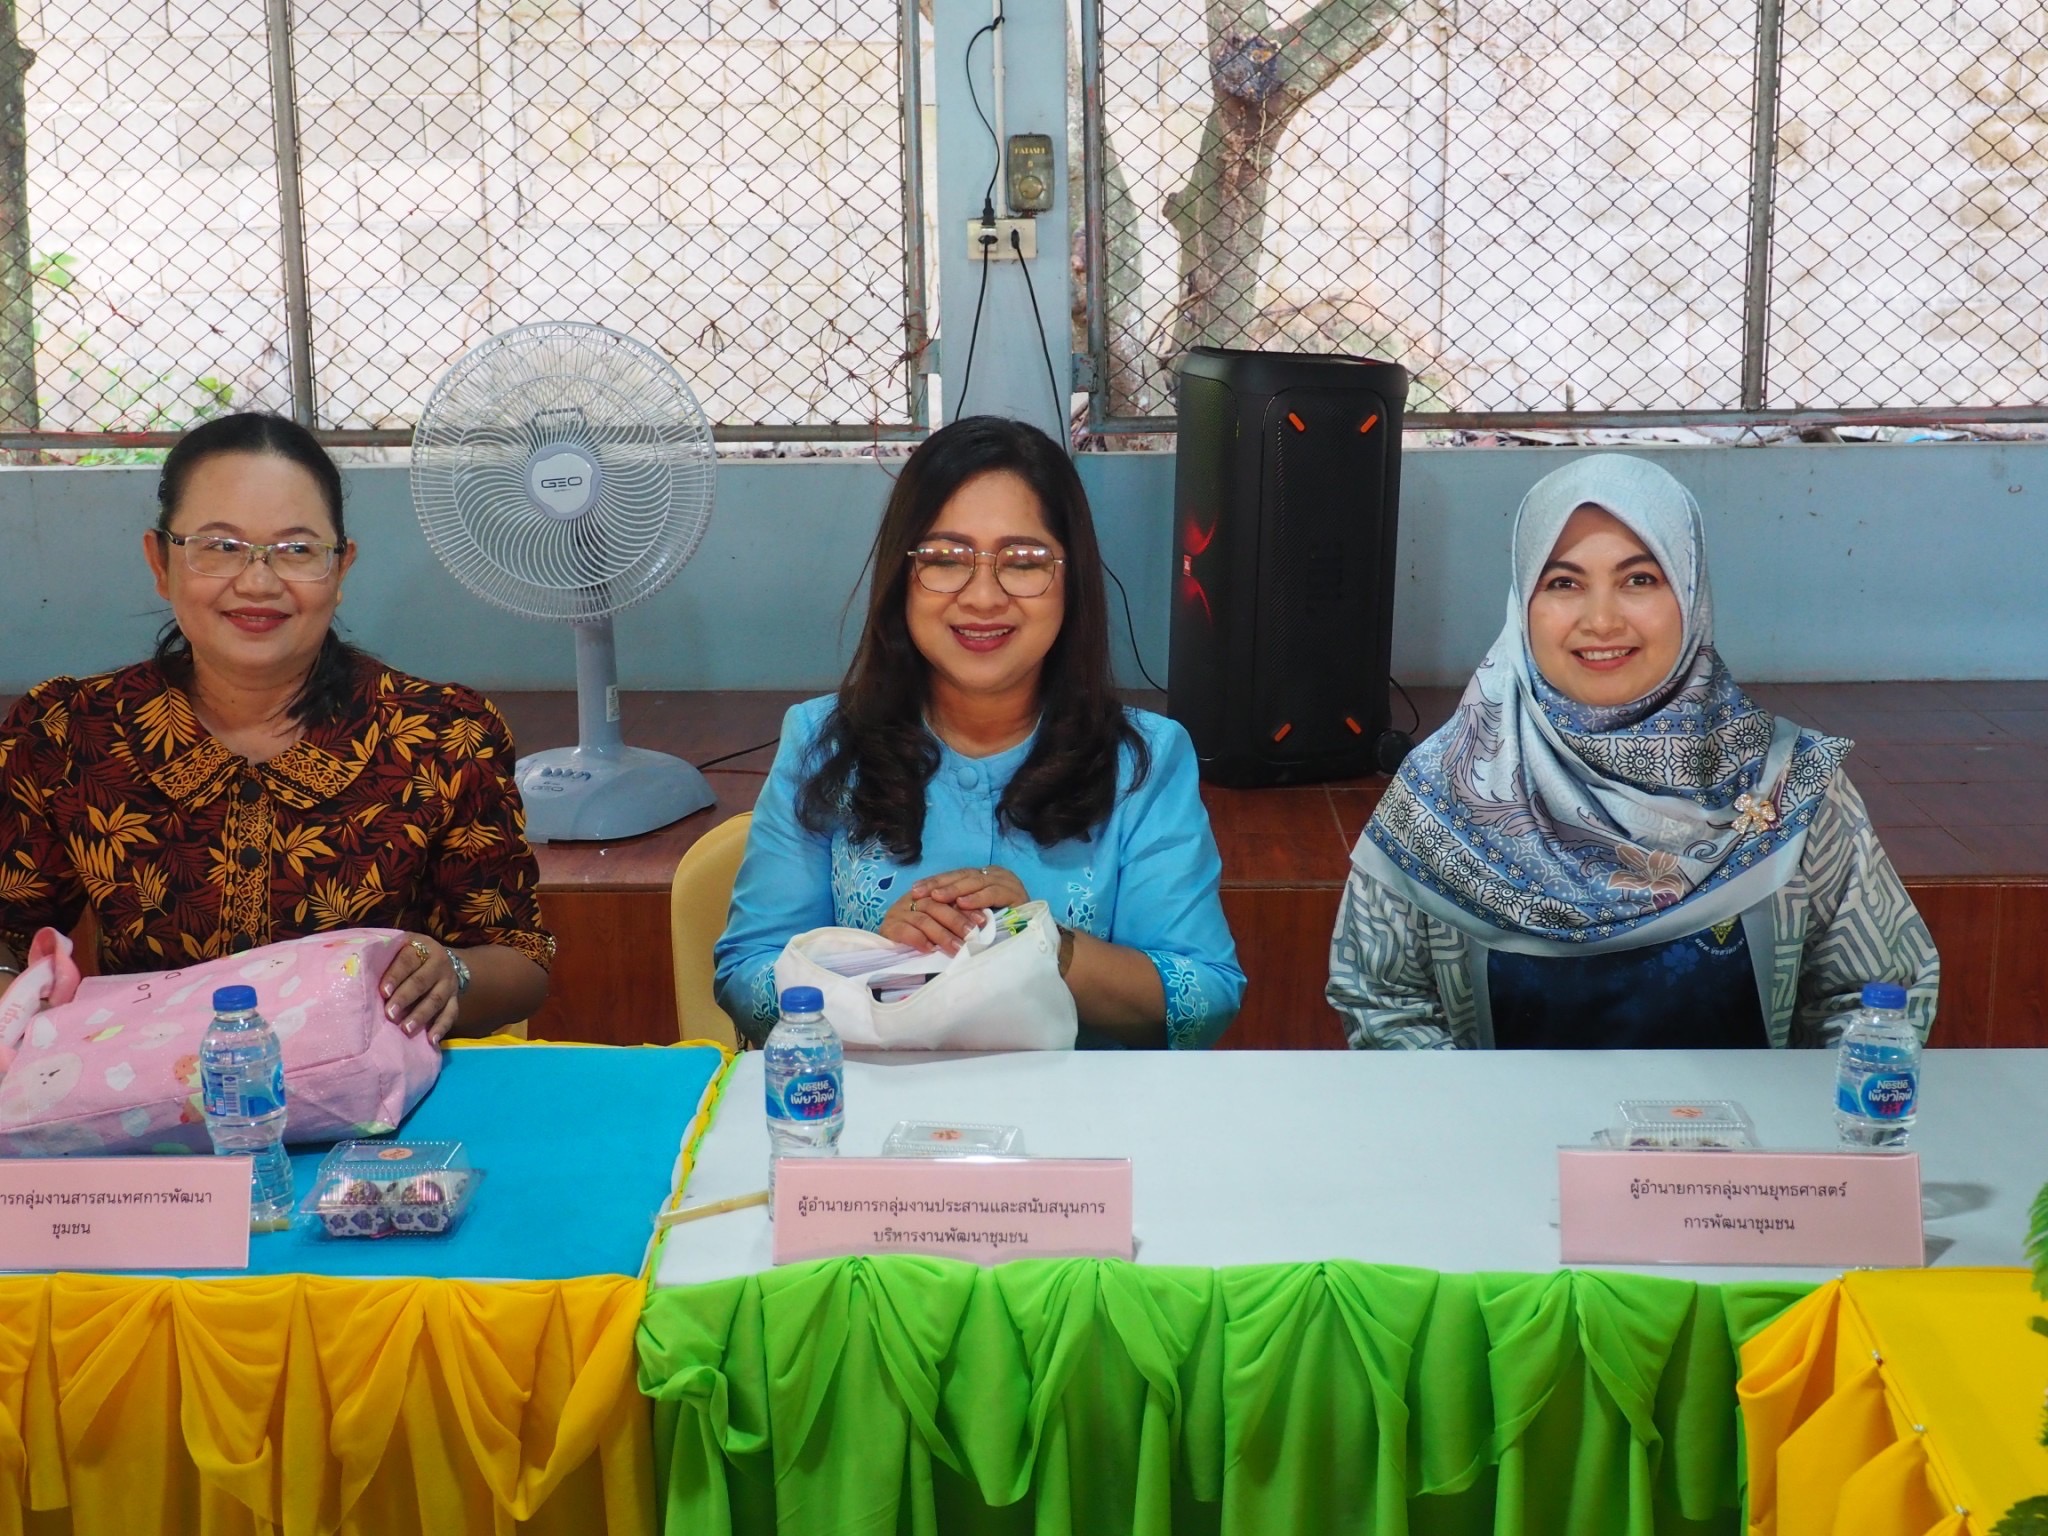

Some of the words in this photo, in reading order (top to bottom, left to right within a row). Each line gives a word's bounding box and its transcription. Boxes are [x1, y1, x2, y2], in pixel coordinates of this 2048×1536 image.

[541, 476, 583, 489] GEO
[52, 1222, 91, 1240] ชุมชน
[1683, 1213, 1795, 1235] การพัฒนาชุมชน
[873, 1226, 1029, 1248] บริหารงานพัฒนาชุมชน
